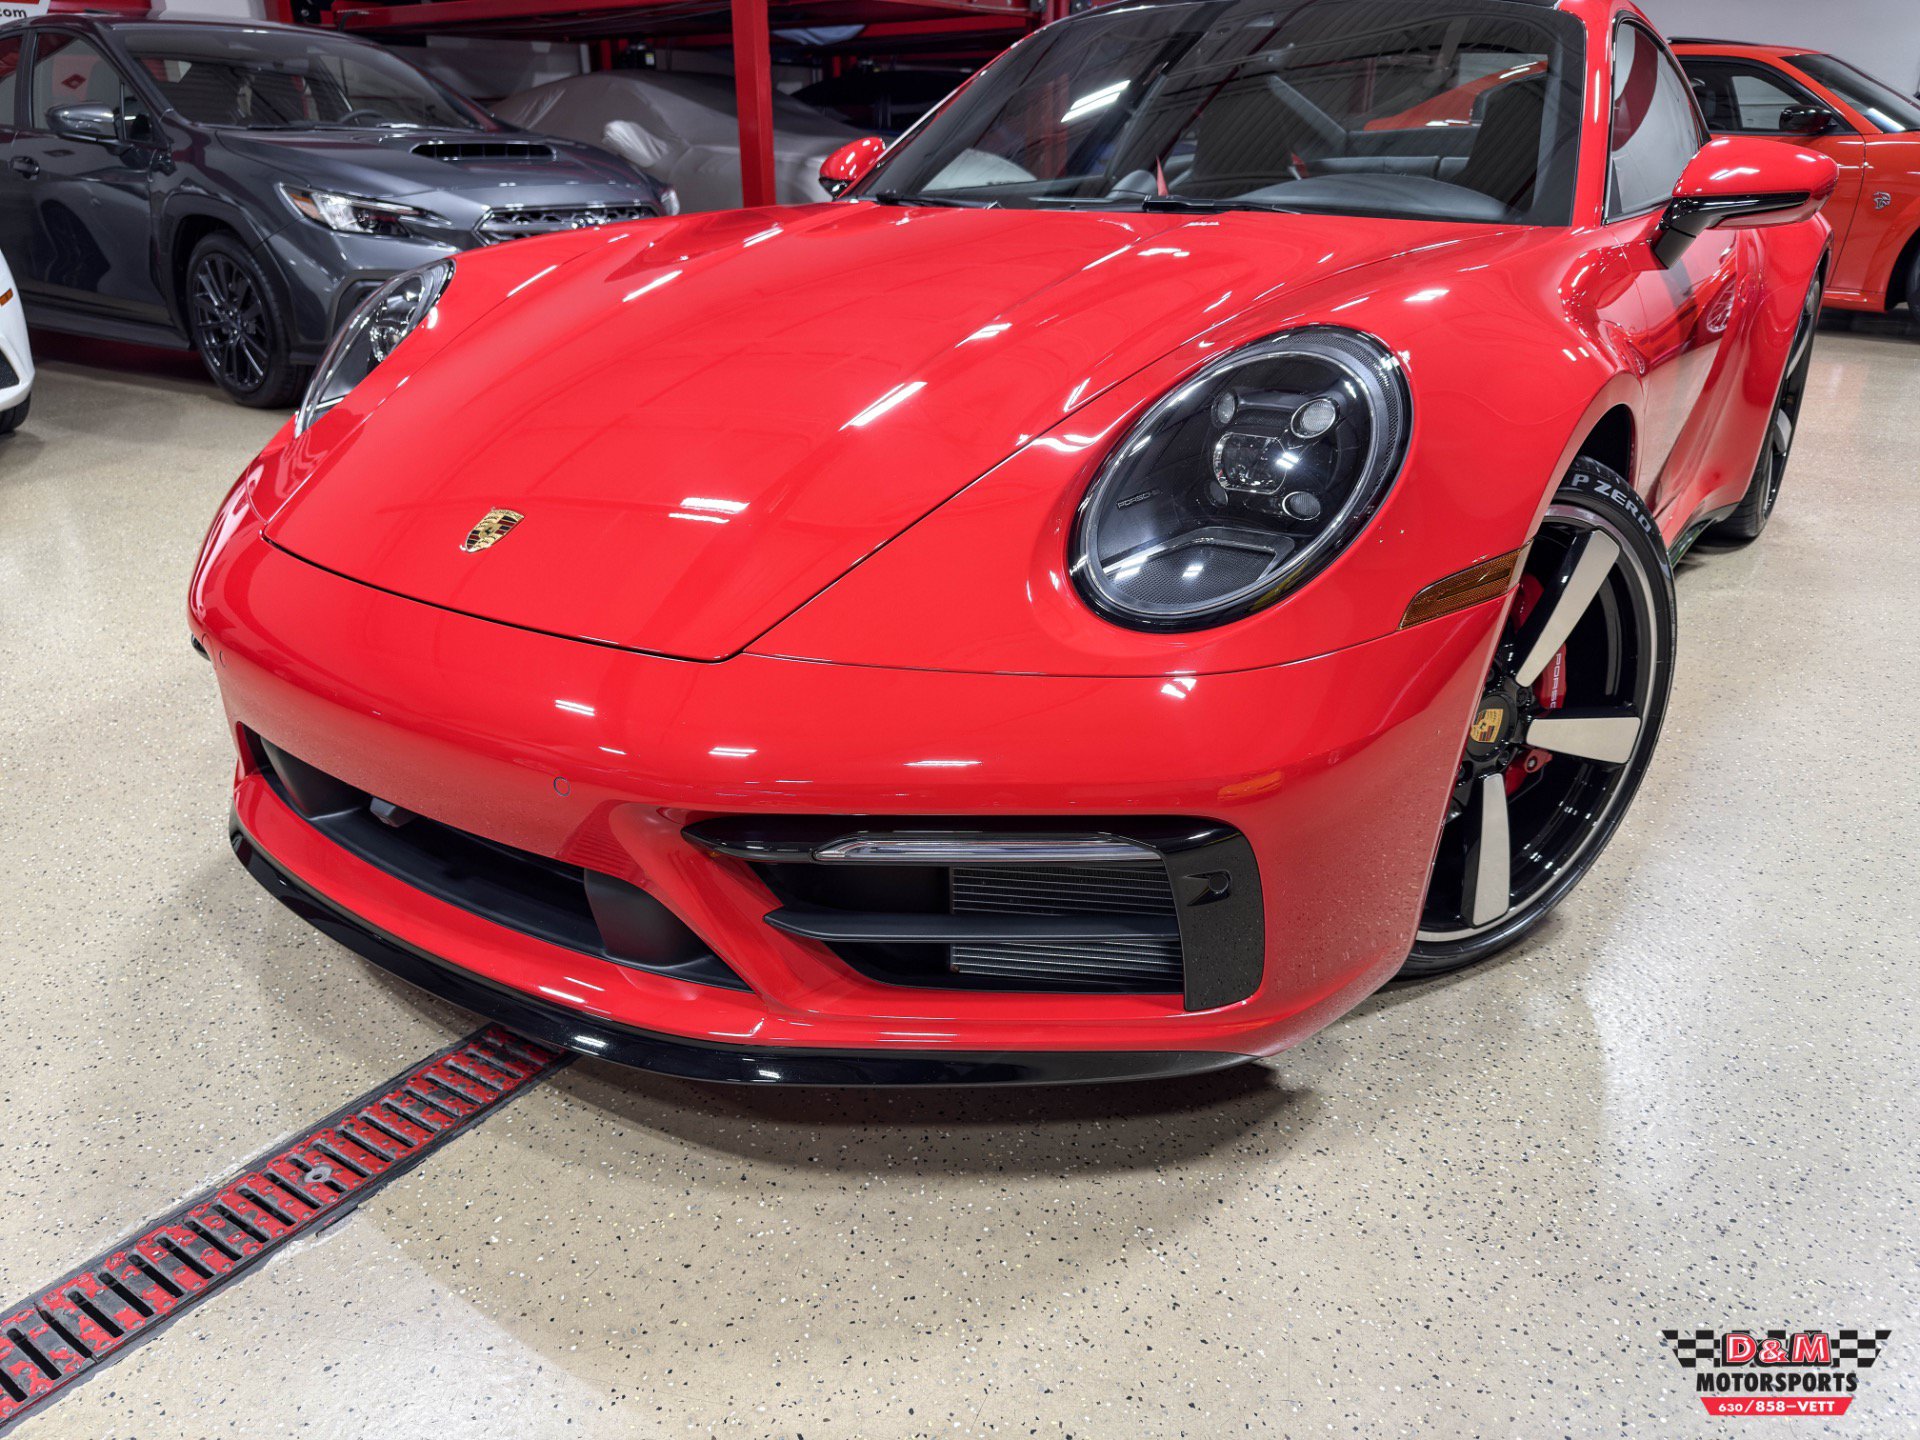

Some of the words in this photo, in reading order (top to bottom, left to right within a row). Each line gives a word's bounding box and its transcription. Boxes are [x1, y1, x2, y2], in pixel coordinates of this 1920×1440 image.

[0, 8, 27, 18] om
[1571, 473, 1589, 487] P
[1594, 480, 1652, 533] ZERO
